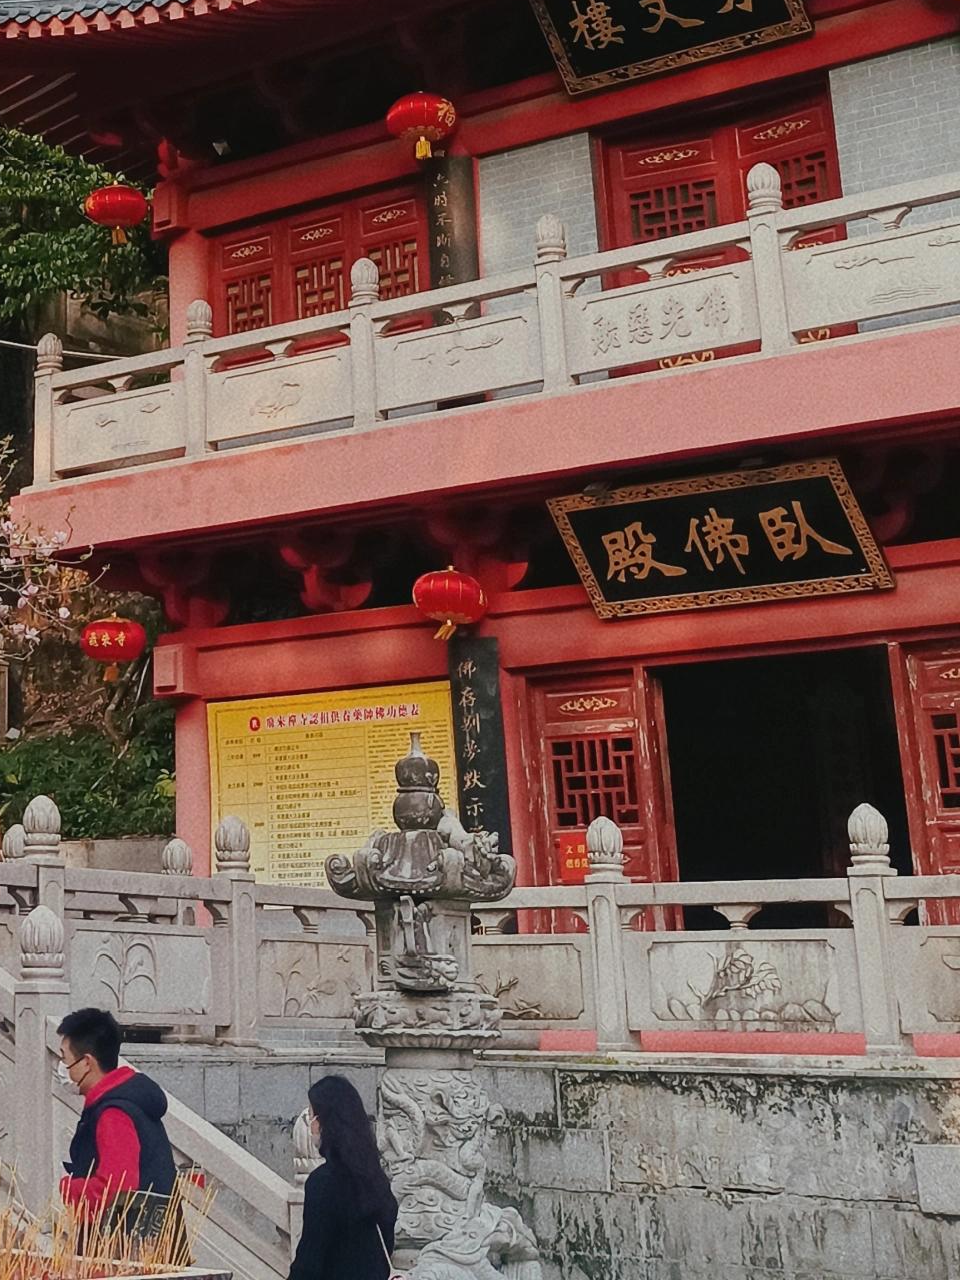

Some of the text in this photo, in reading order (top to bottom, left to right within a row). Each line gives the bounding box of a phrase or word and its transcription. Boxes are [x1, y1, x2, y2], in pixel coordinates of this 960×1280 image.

[437, 98, 456, 127] 福
[601, 500, 853, 583] 臥佛殿
